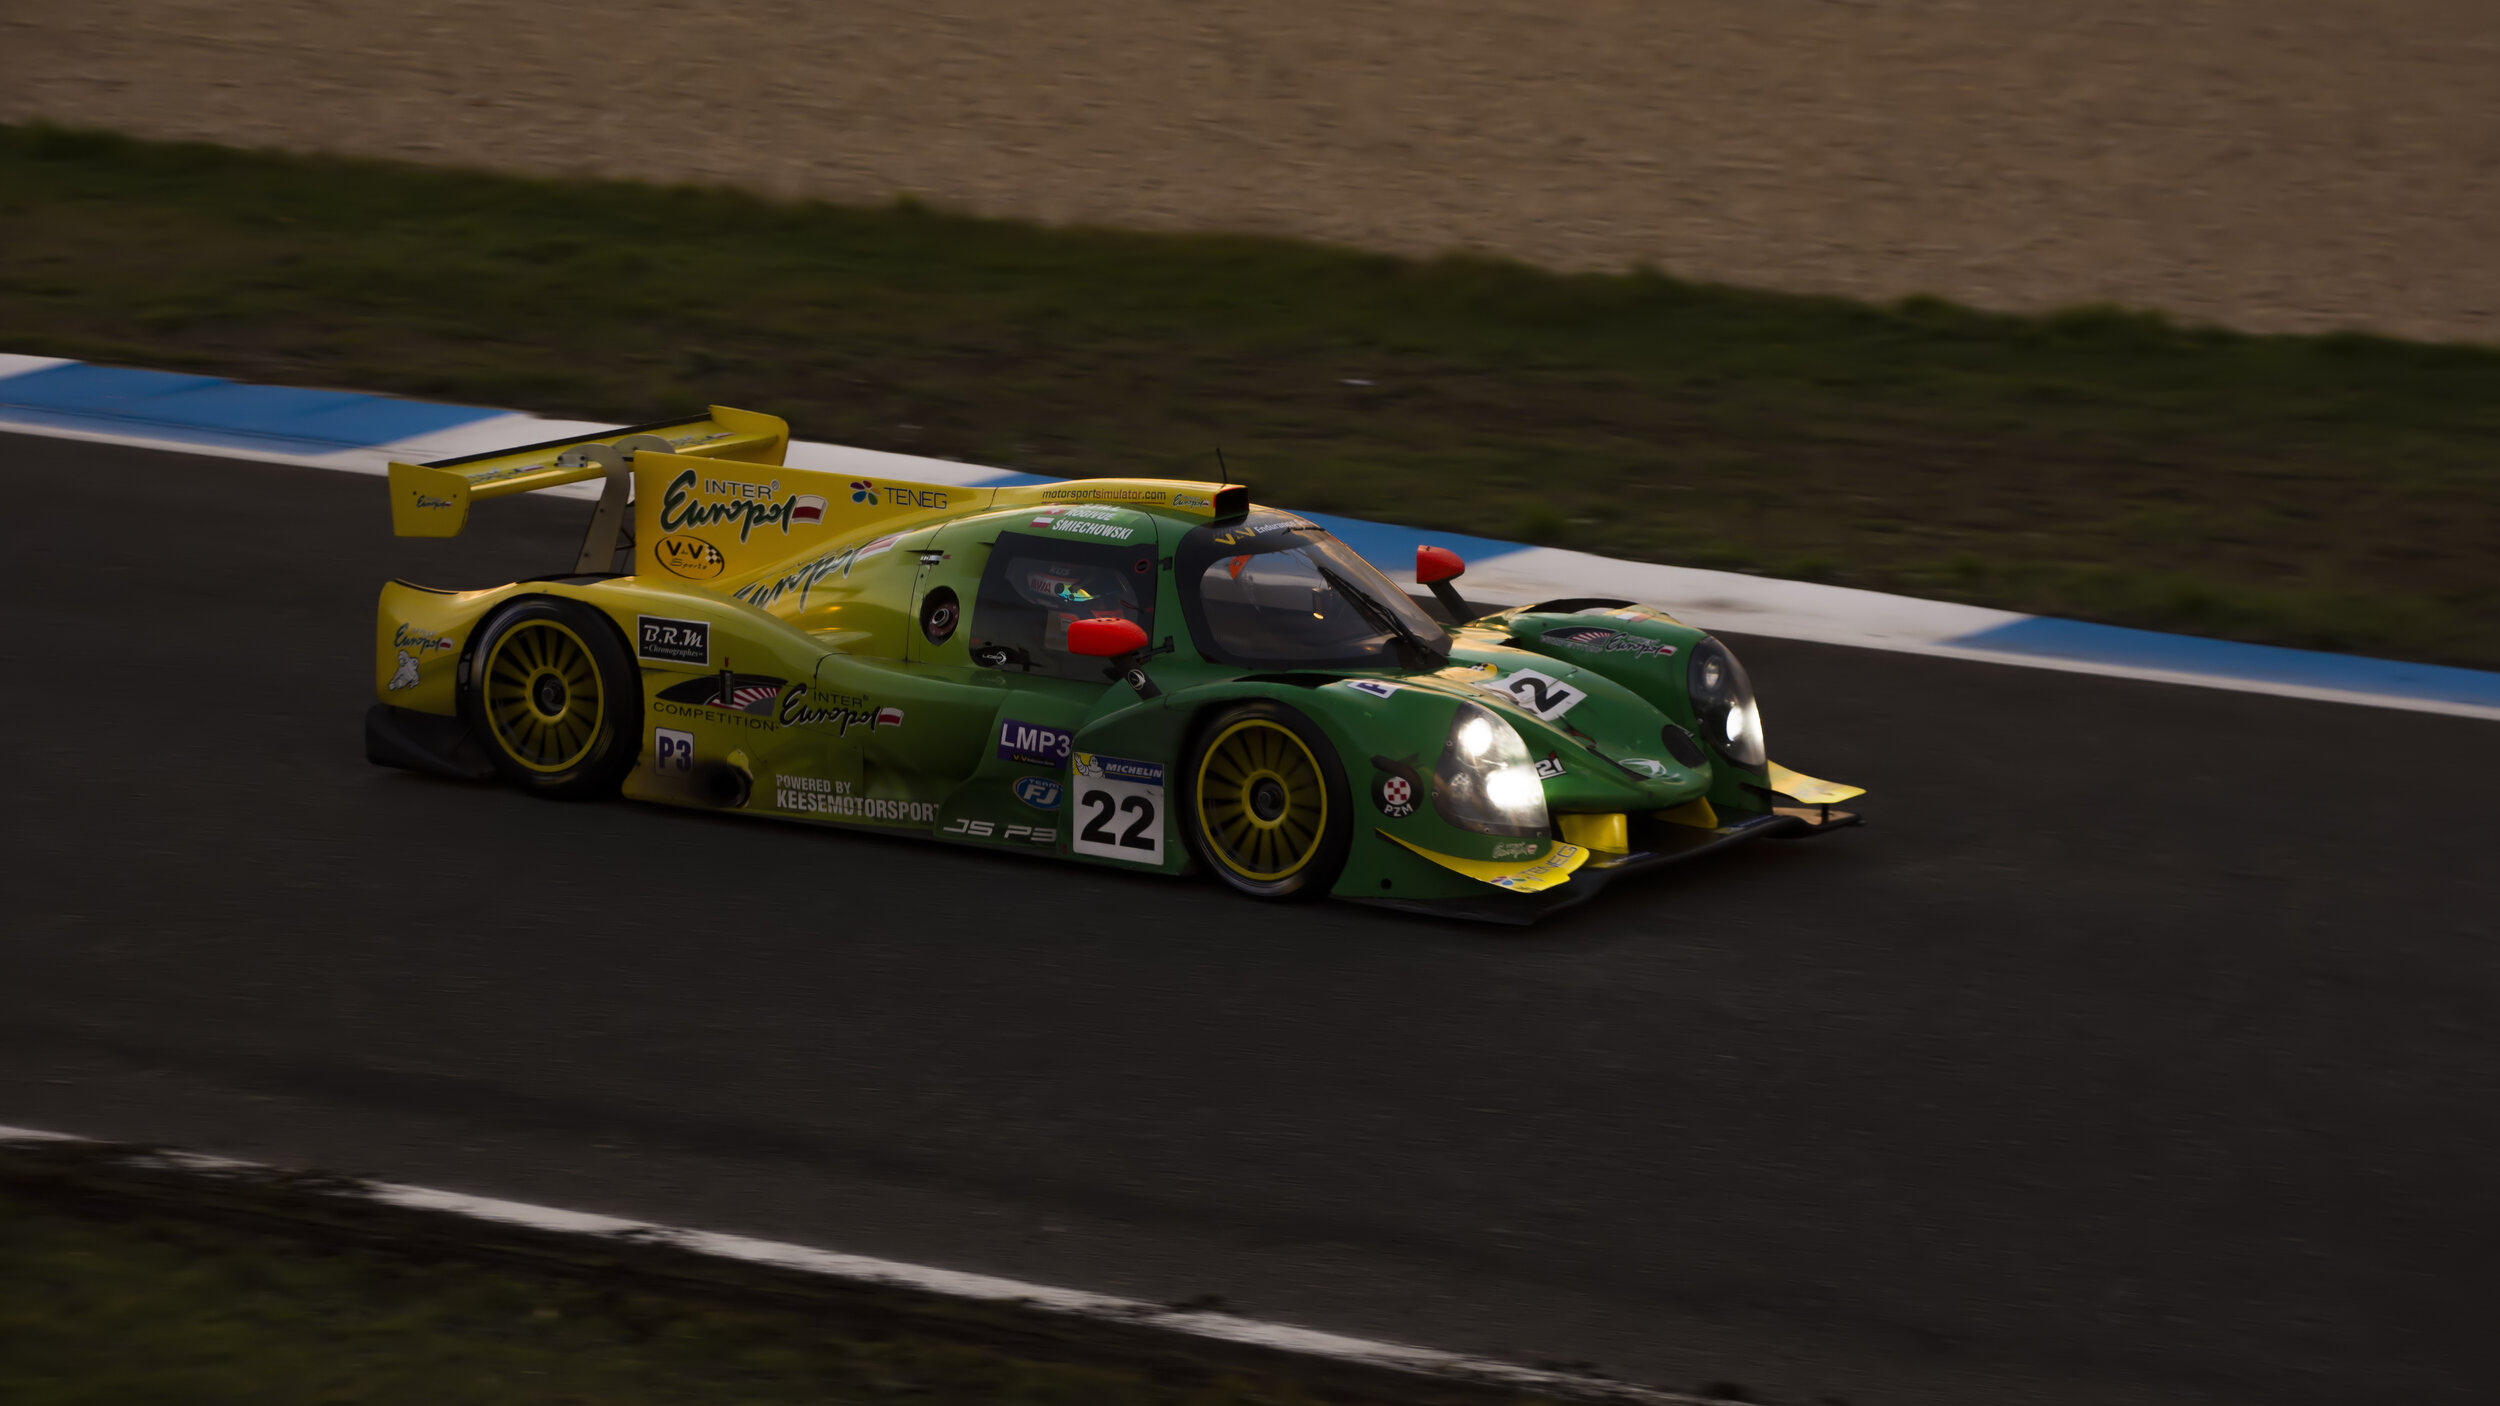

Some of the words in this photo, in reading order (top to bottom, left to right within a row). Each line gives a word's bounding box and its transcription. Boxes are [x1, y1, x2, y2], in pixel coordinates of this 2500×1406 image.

[660, 469, 797, 543] Europol
[884, 487, 948, 509] TENEG
[1042, 488, 1167, 501] motorsportsimulator.com
[1052, 519, 1134, 540] ŚMIECHOWSKI
[643, 624, 704, 648] B.R.M
[780, 683, 882, 738] Europol
[1000, 723, 1073, 758] LMP3
[658, 736, 692, 773] P3
[1105, 762, 1163, 779] MICHELIN
[776, 774, 831, 793] POWERED
[835, 781, 852, 794] BY
[1023, 783, 1059, 805] FJ
[1080, 789, 1156, 851] 22
[1383, 802, 1415, 818] PZM
[943, 818, 996, 837] JS
[1004, 824, 1058, 843] P3
